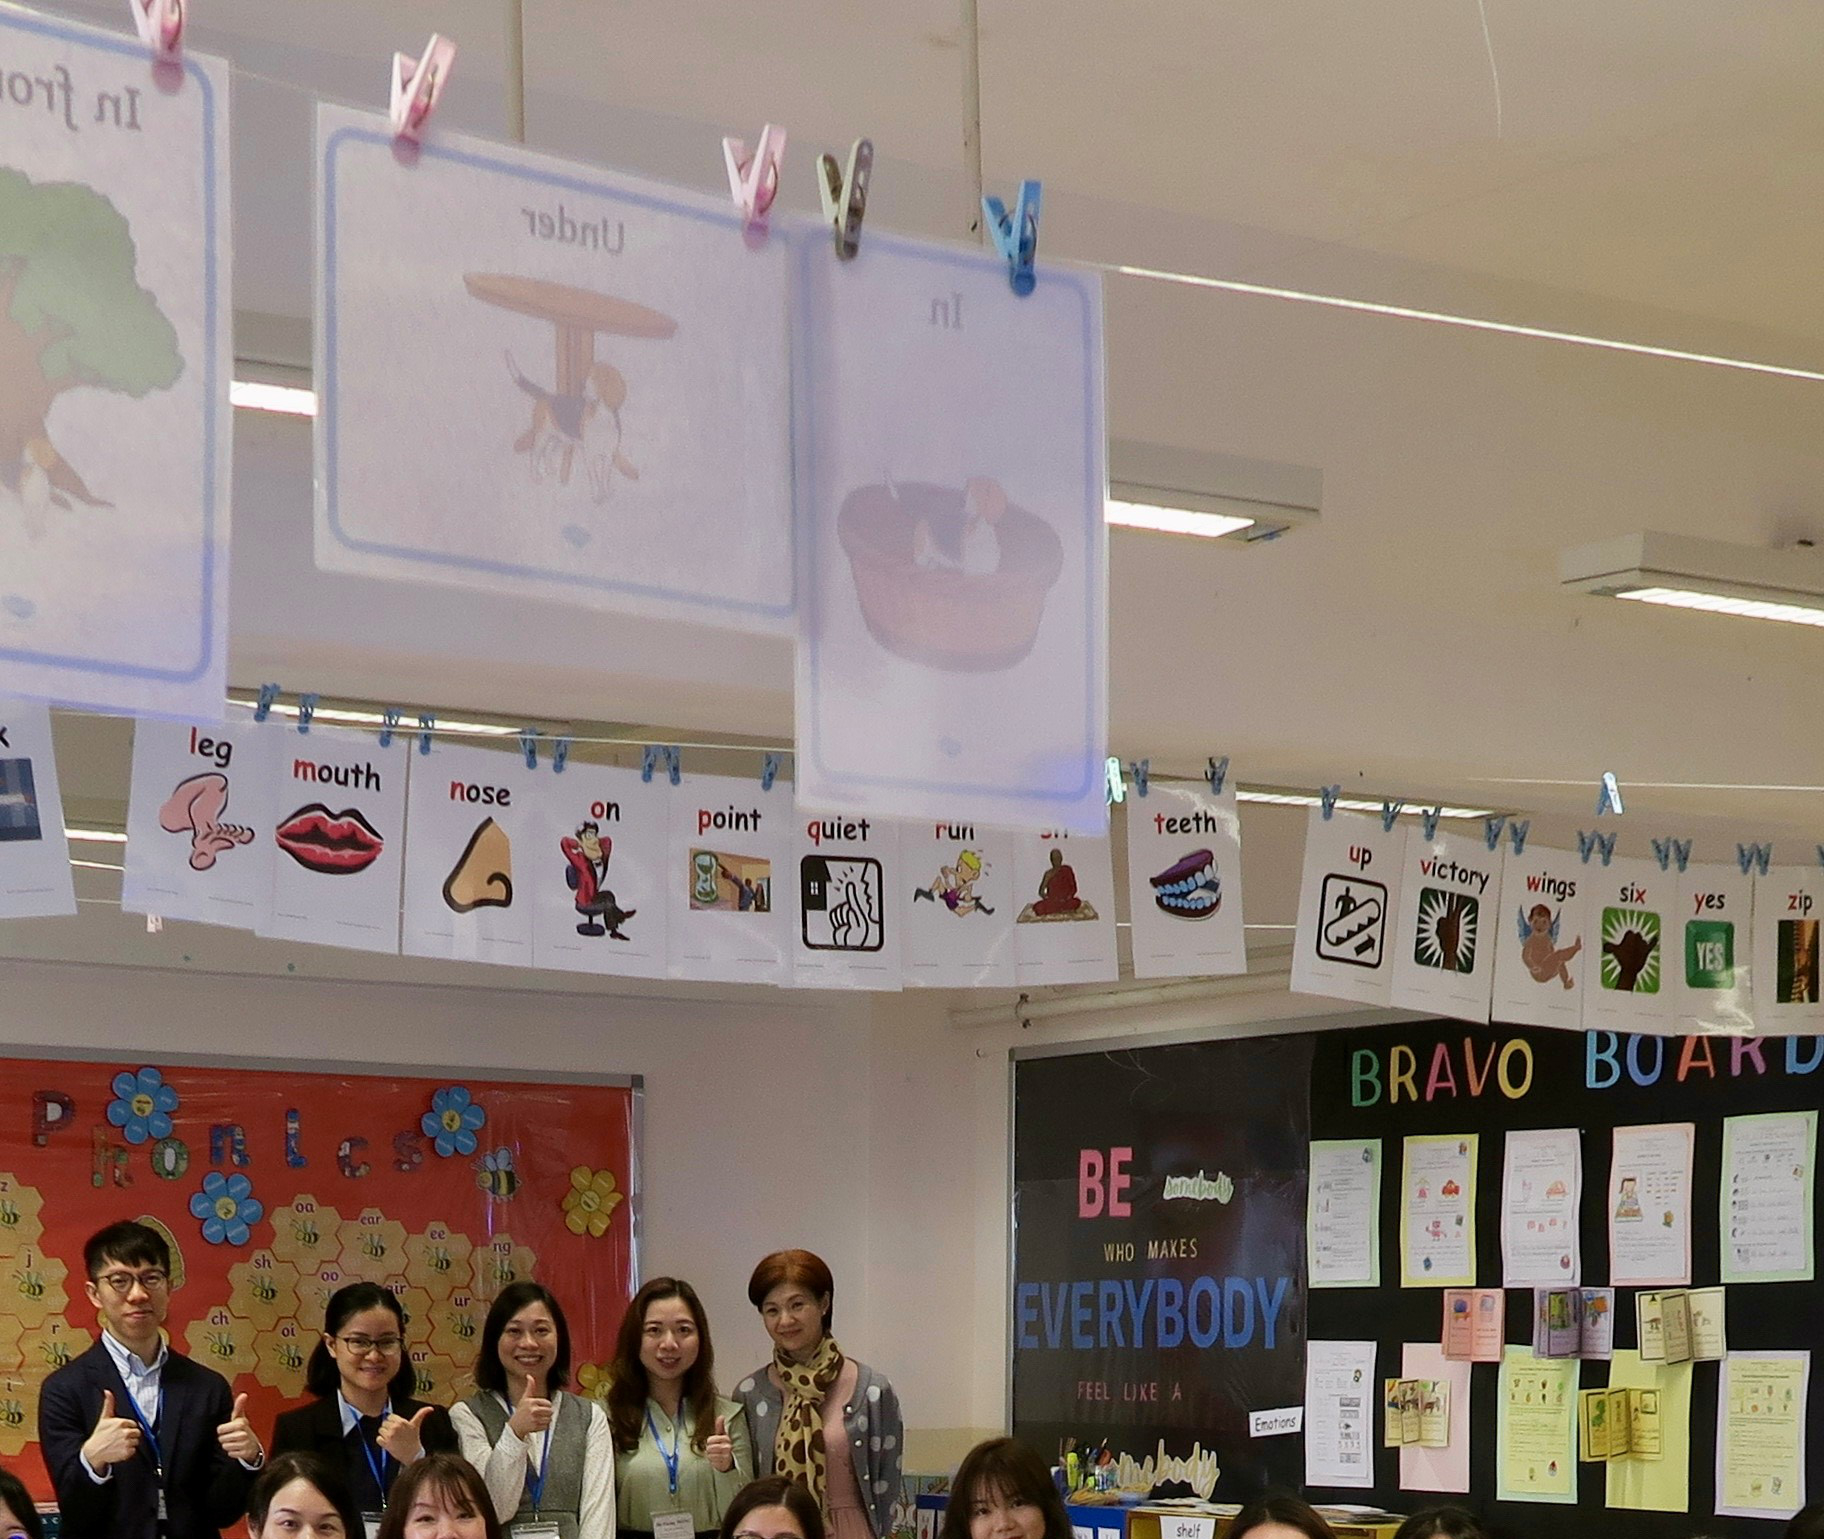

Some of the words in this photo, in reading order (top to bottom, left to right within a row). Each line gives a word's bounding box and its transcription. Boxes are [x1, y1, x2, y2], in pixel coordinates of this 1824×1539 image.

[189, 726, 233, 768] leg
[293, 755, 381, 792] mouth
[449, 778, 511, 808] nose
[590, 798, 620, 822] on
[697, 807, 762, 835] point
[807, 816, 870, 847] quiet
[1153, 811, 1217, 837] teeth
[1349, 844, 1372, 872] up
[1420, 856, 1490, 894] victory
[1526, 872, 1576, 899] wings
[1619, 884, 1646, 905] six
[1694, 890, 1725, 914] yes
[1788, 891, 1813, 916] zip
[1696, 940, 1722, 969] YES
[1352, 1036, 1533, 1107] BRAVO
[1079, 1146, 1133, 1219] BE
[1163, 1169, 1234, 1204] somebody
[295, 1203, 315, 1214] oa
[360, 1214, 382, 1226] ear
[430, 1230, 446, 1240] ee
[493, 1241, 511, 1256] ng
[1103, 1241, 1135, 1262] WHO
[1147, 1238, 1199, 1260] MAKES
[254, 1254, 272, 1269] sh
[321, 1272, 339, 1282] oo
[387, 1280, 407, 1296] air
[454, 1295, 470, 1307] ur
[1017, 1275, 1289, 1349] EVERYBODY
[211, 1311, 229, 1326] ch
[281, 1322, 296, 1337] oi
[412, 1351, 428, 1362] ar
[1078, 1381, 1110, 1401] FEEL
[1124, 1381, 1158, 1401] LIKE
[1171, 1382, 1182, 1400] A
[1255, 1415, 1297, 1432] Emotions
[1176, 1522, 1202, 1539] shelf
